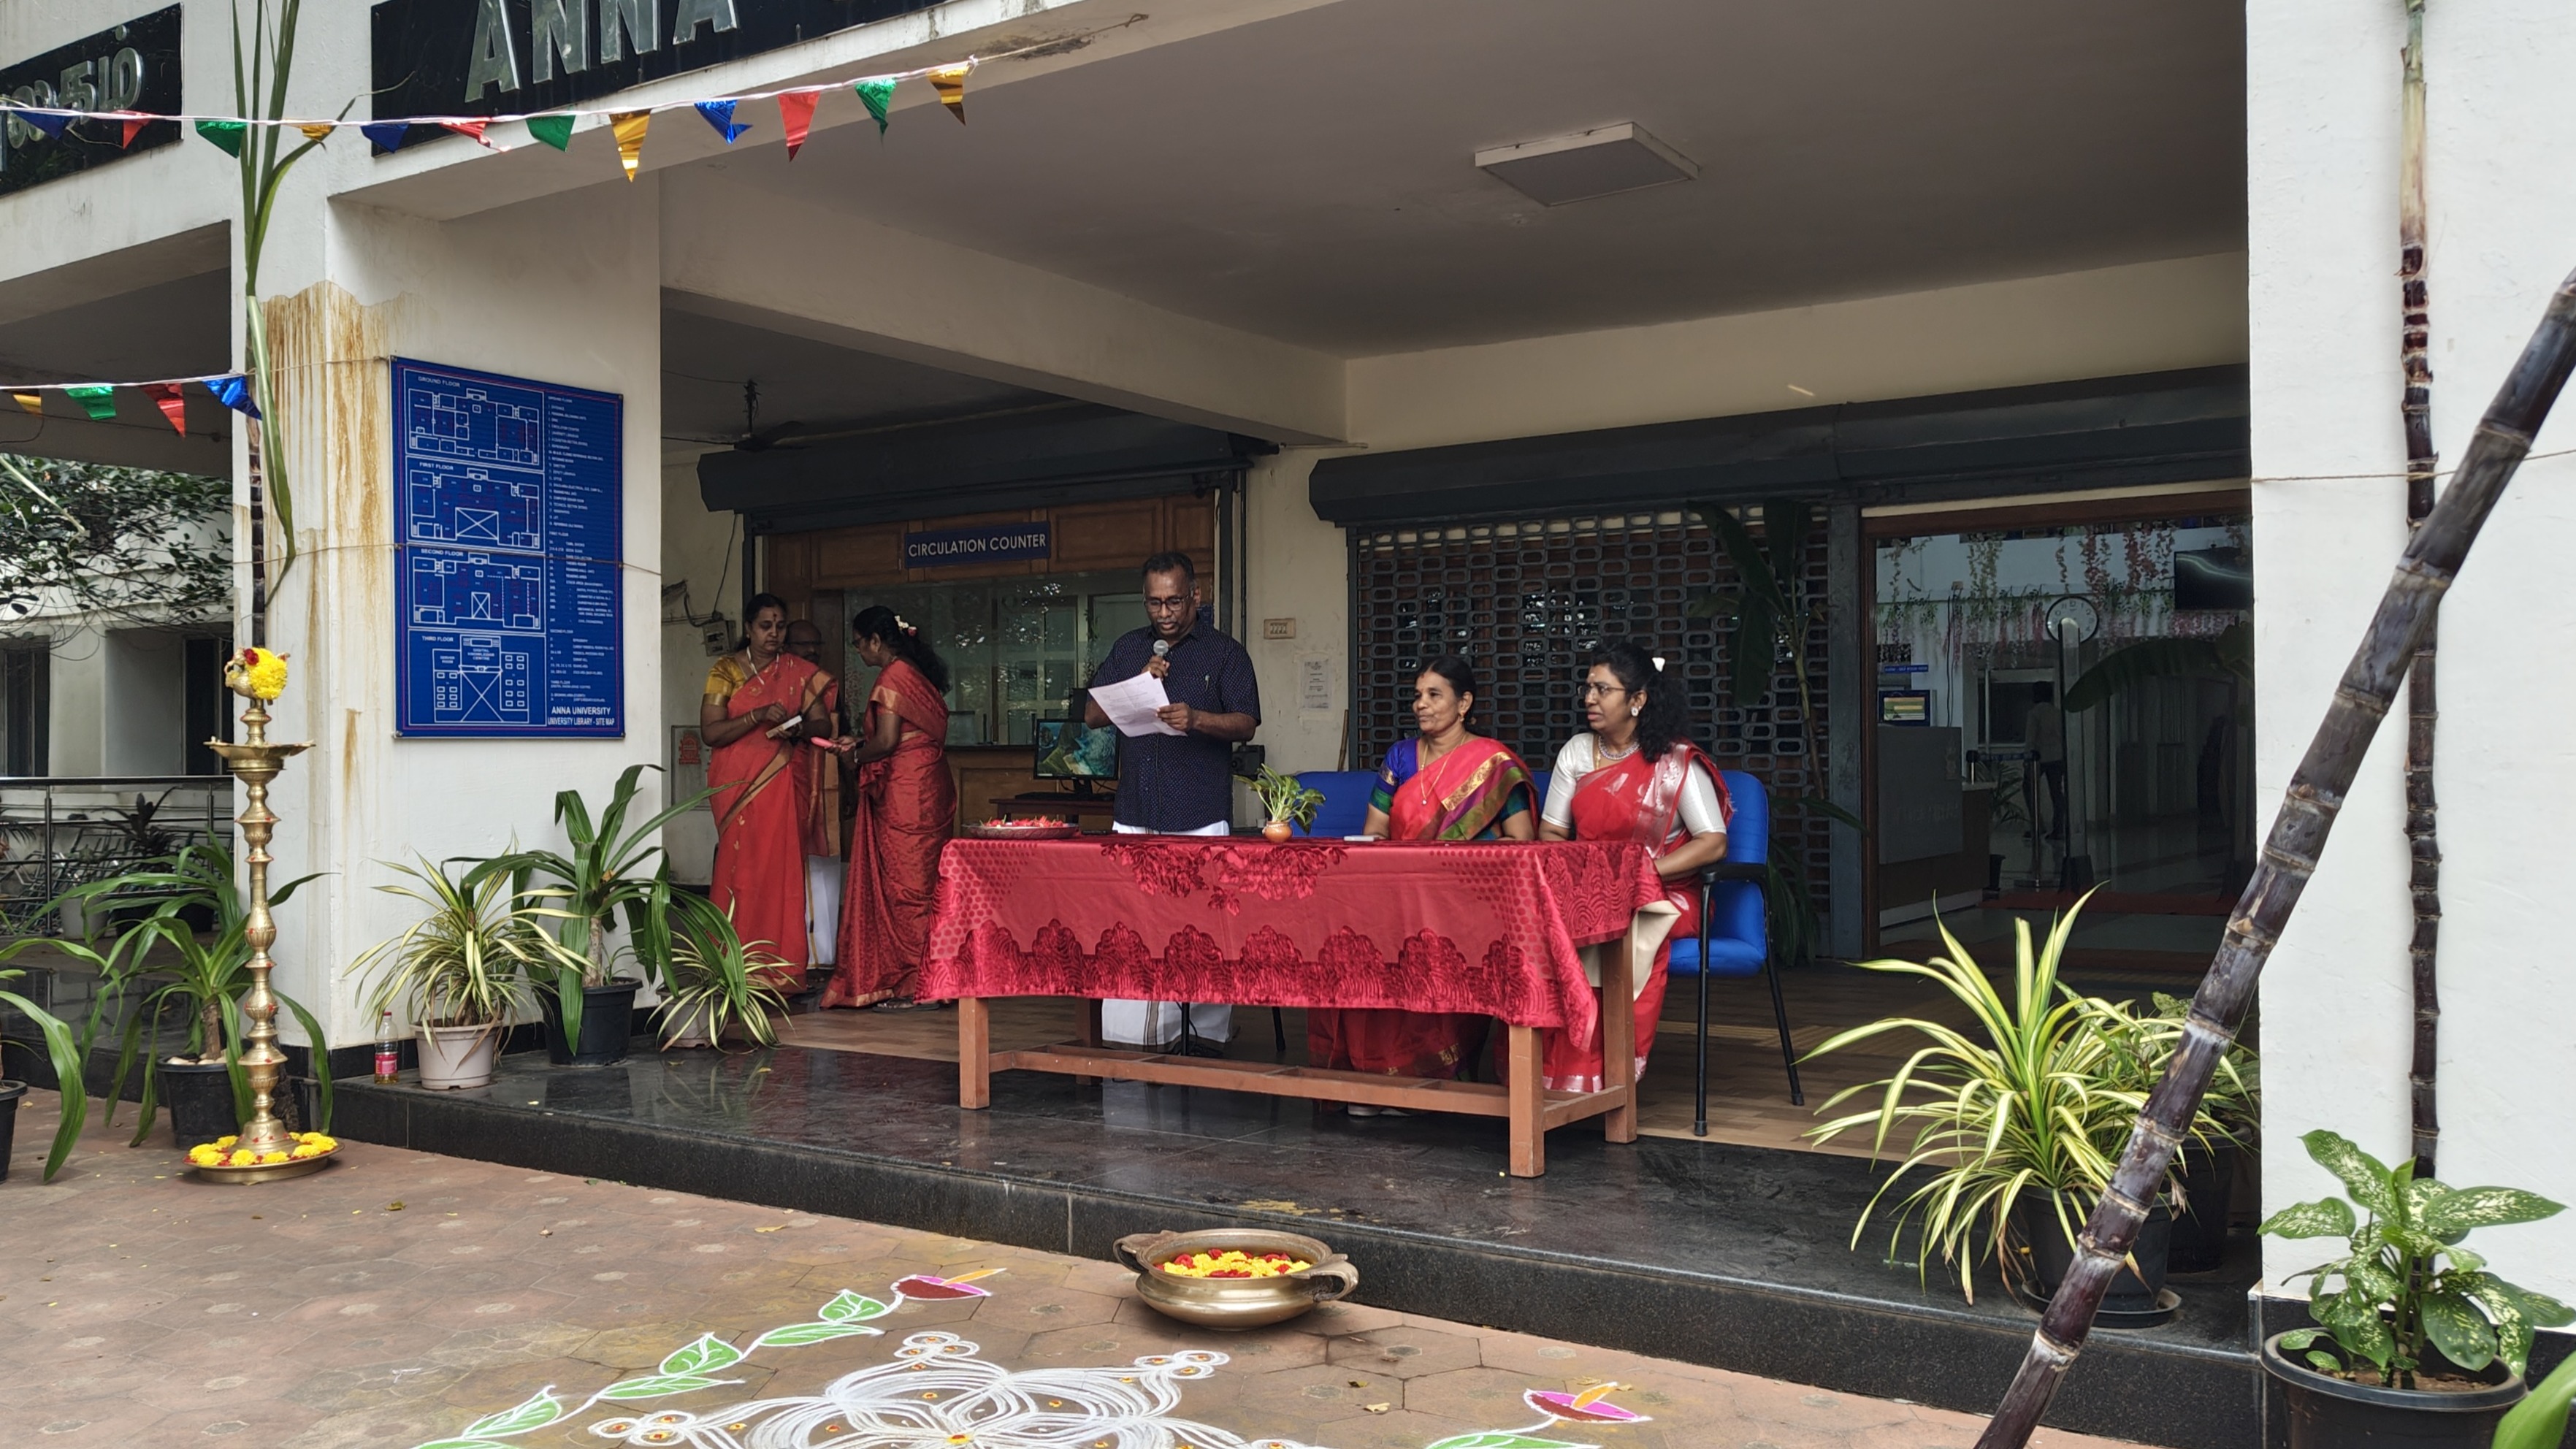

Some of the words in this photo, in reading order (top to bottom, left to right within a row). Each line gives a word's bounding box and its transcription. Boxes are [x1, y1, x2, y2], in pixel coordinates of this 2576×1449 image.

[418, 376, 441, 384] GROUND
[908, 538, 986, 557] CIRCULATION
[990, 534, 1047, 551] COUNTER
[551, 706, 571, 715] ANNA
[572, 706, 611, 715] UNIVERSITY
[547, 716, 573, 725] UNIVERSITY
[573, 717, 593, 726] LIBRARY
[595, 718, 605, 726] SITE
[605, 718, 615, 726] MAP
